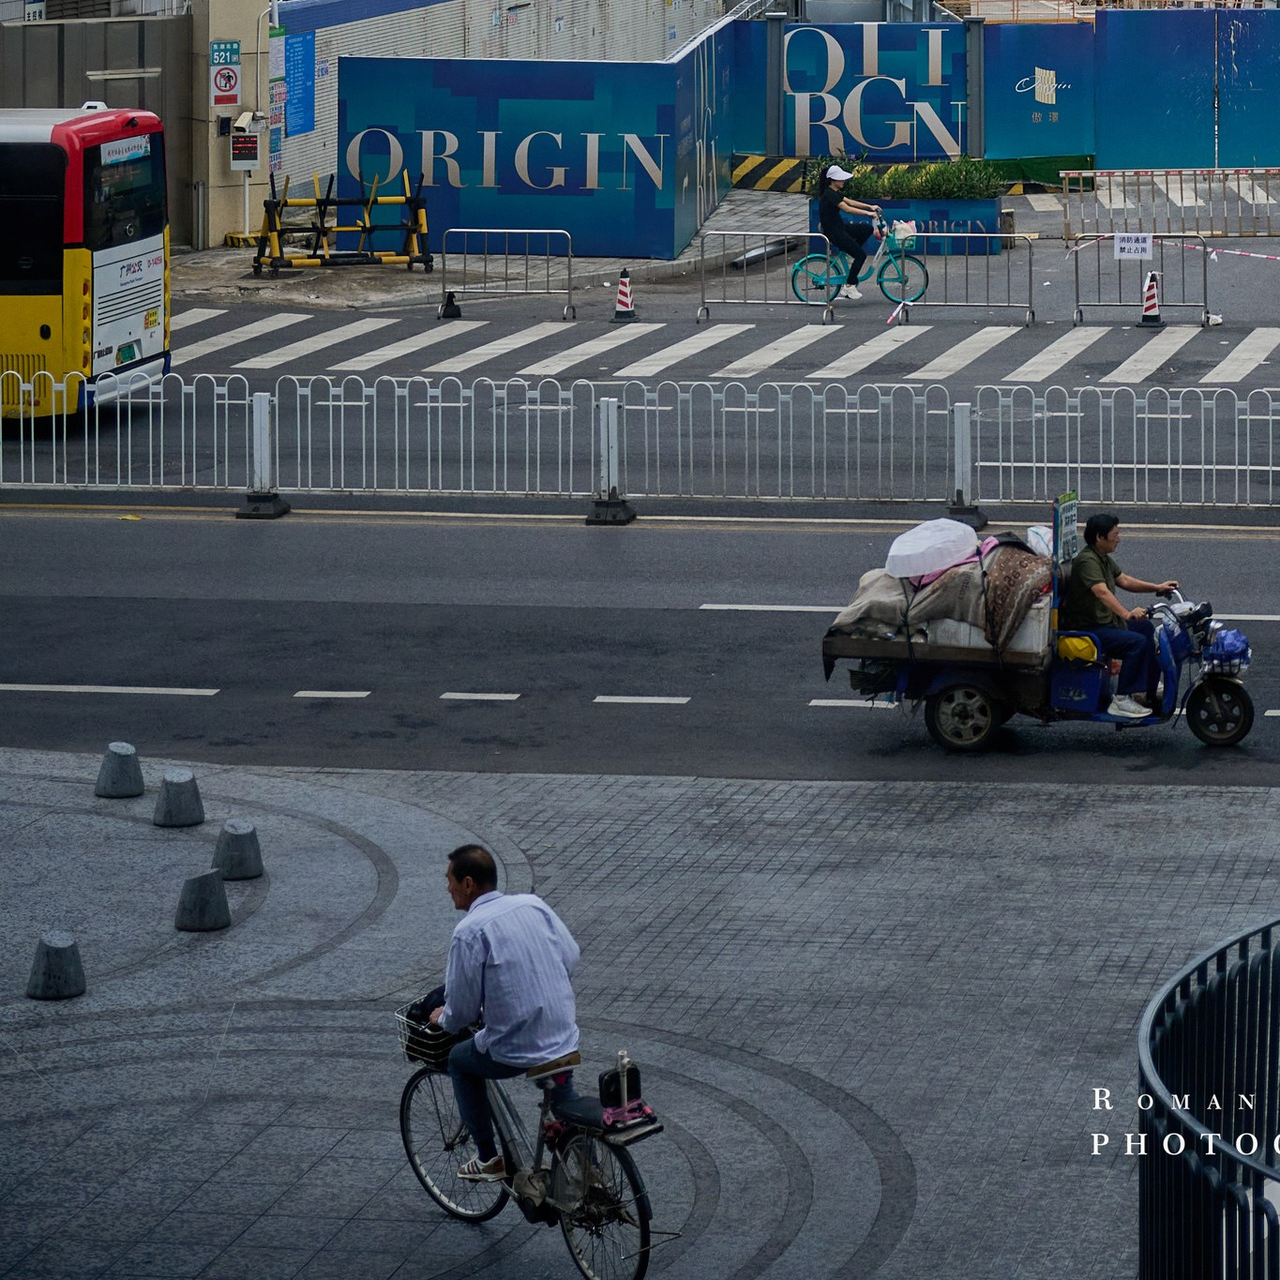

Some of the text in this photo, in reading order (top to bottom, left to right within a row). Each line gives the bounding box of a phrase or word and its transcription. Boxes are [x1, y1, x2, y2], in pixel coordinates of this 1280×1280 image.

[213, 51, 230, 64] 521
[346, 128, 671, 190] ORIGIN
[1120, 246, 1147, 254] 禁止占用
